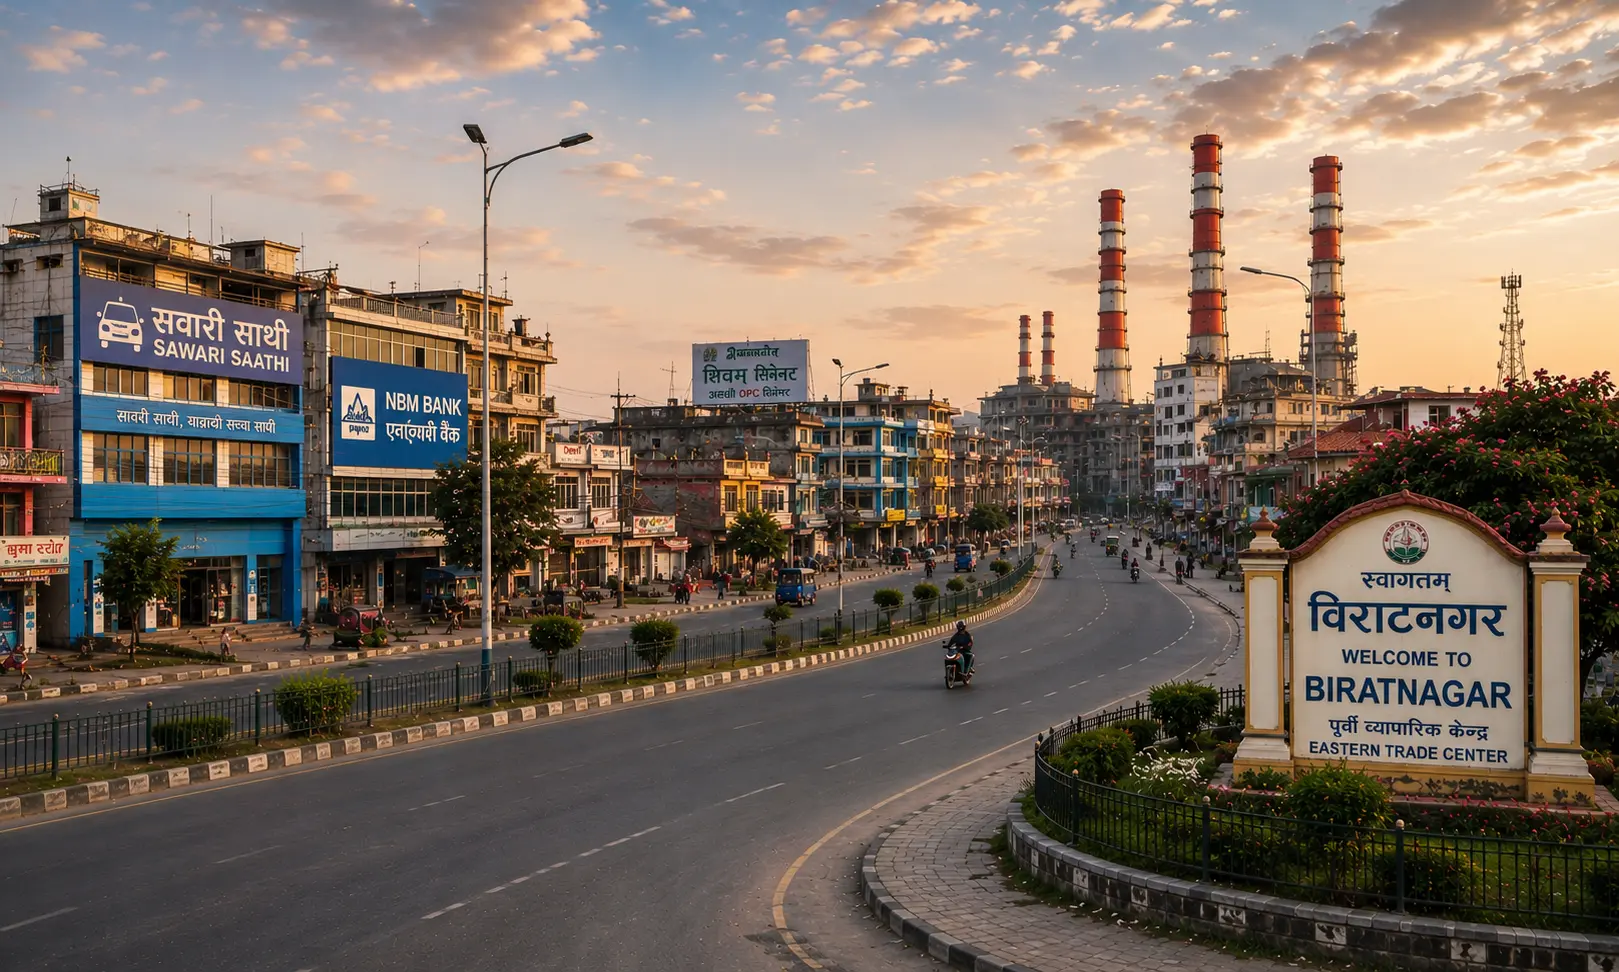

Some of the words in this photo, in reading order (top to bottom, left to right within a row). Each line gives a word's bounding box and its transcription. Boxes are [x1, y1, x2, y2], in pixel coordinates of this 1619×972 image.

[150, 307, 225, 342] सवारी
[233, 318, 290, 351] साथी
[153, 338, 225, 365] SAWARI
[231, 350, 289, 373] SAATHI
[385, 391, 419, 413] NBM
[423, 395, 462, 416] BANK
[739, 388, 760, 398] OPC
[1361, 571, 1451, 592] स्वागतम्
[1307, 591, 1507, 637] विराटनगर
[1342, 648, 1438, 667] WELCOME
[1445, 651, 1472, 668] TO
[1305, 675, 1512, 709] BIRATNAGAR
[1364, 718, 1442, 737] व्यापारिक
[1448, 719, 1489, 741] केन्द्र
[1309, 740, 1381, 757] EASTERN
[1384, 744, 1438, 760] TRADE
[1442, 746, 1508, 763] CENTER
